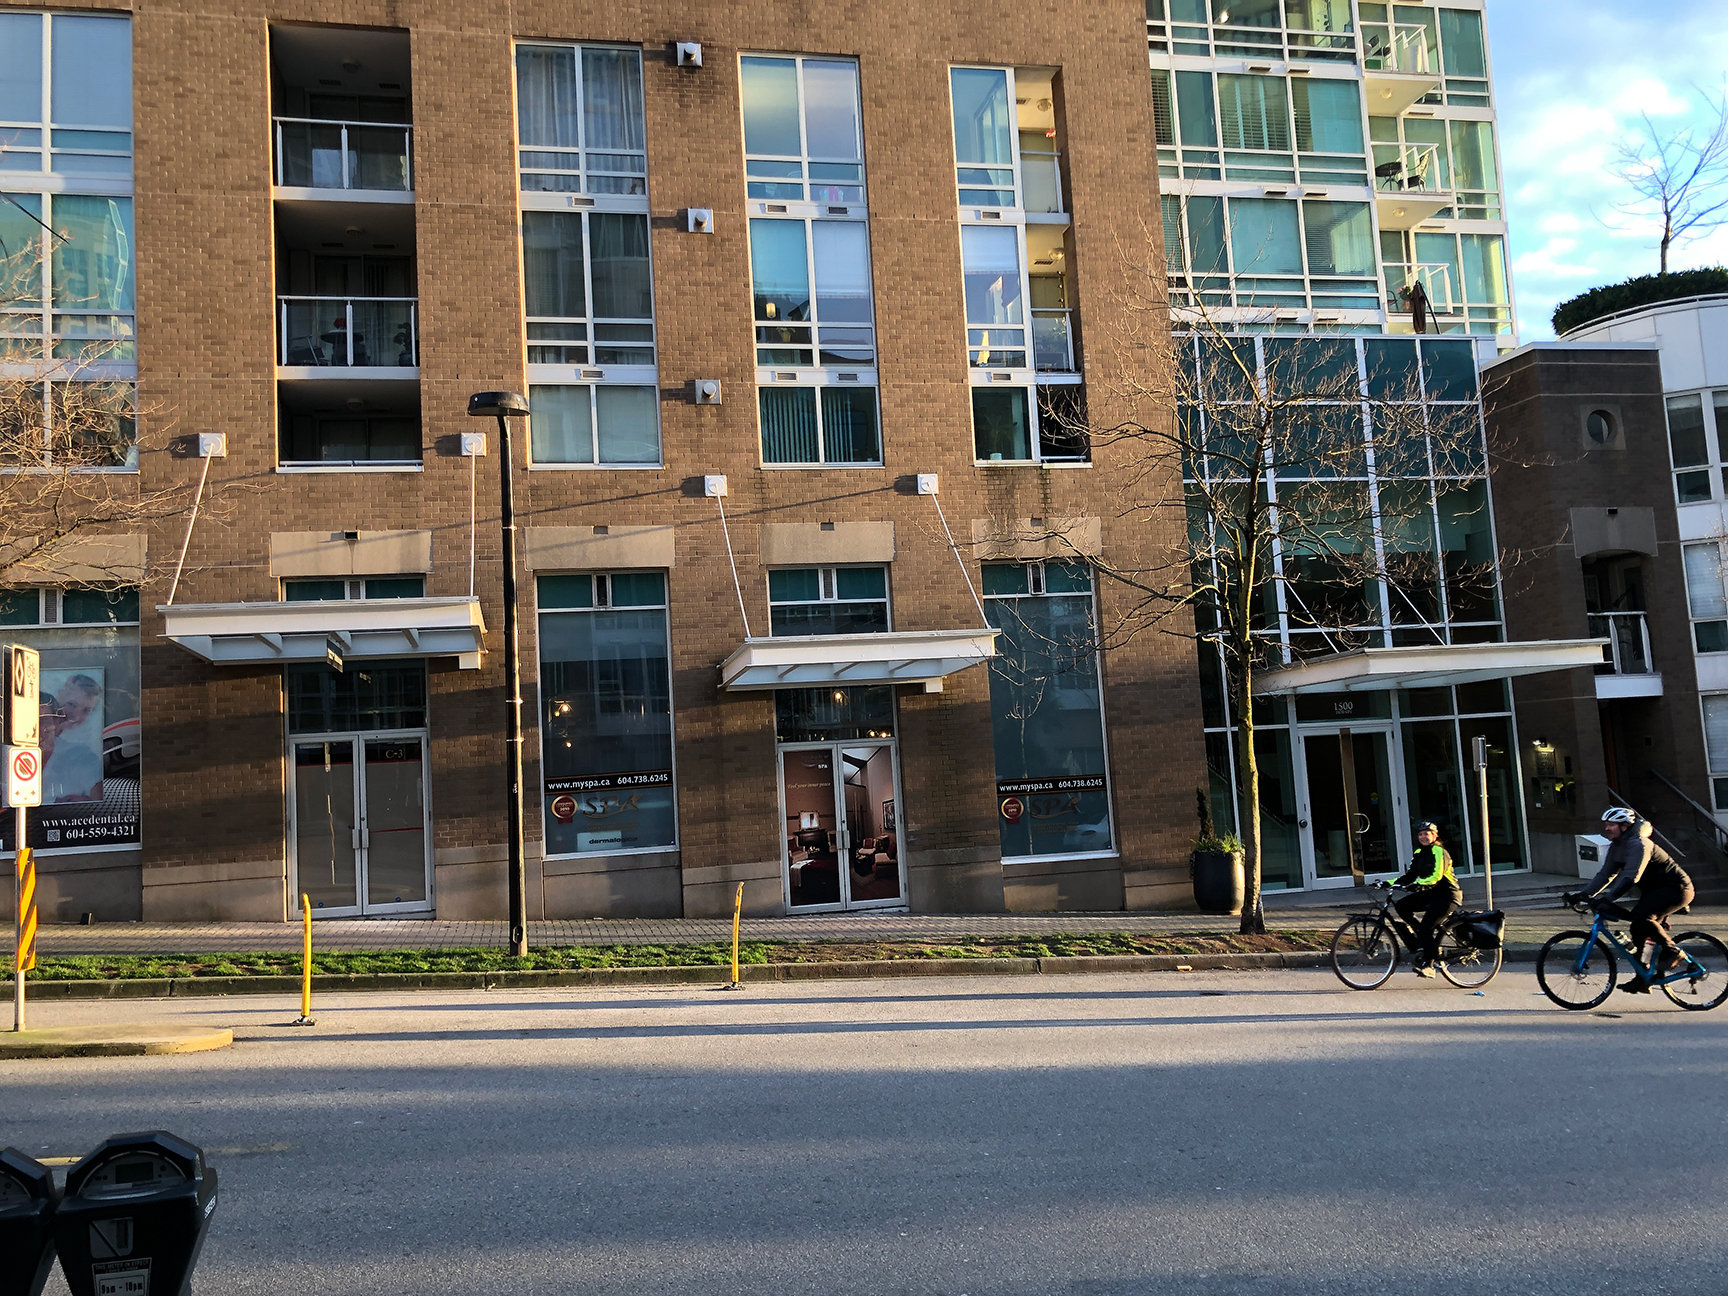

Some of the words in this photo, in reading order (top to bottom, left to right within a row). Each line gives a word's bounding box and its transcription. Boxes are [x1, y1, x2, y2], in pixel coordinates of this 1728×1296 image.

[385, 749, 403, 759] C-3
[548, 779, 610, 790] www.myspa.ca
[617, 773, 668, 785] 604.738.6245
[999, 782, 1053, 792] www.myspa.ca
[1058, 779, 1103, 789] 604.738.6245
[583, 794, 643, 815] SPA
[1031, 797, 1079, 815] SPA
[42, 813, 135, 827] www.acedental.ca
[66, 826, 134, 839] 604-559-4321
